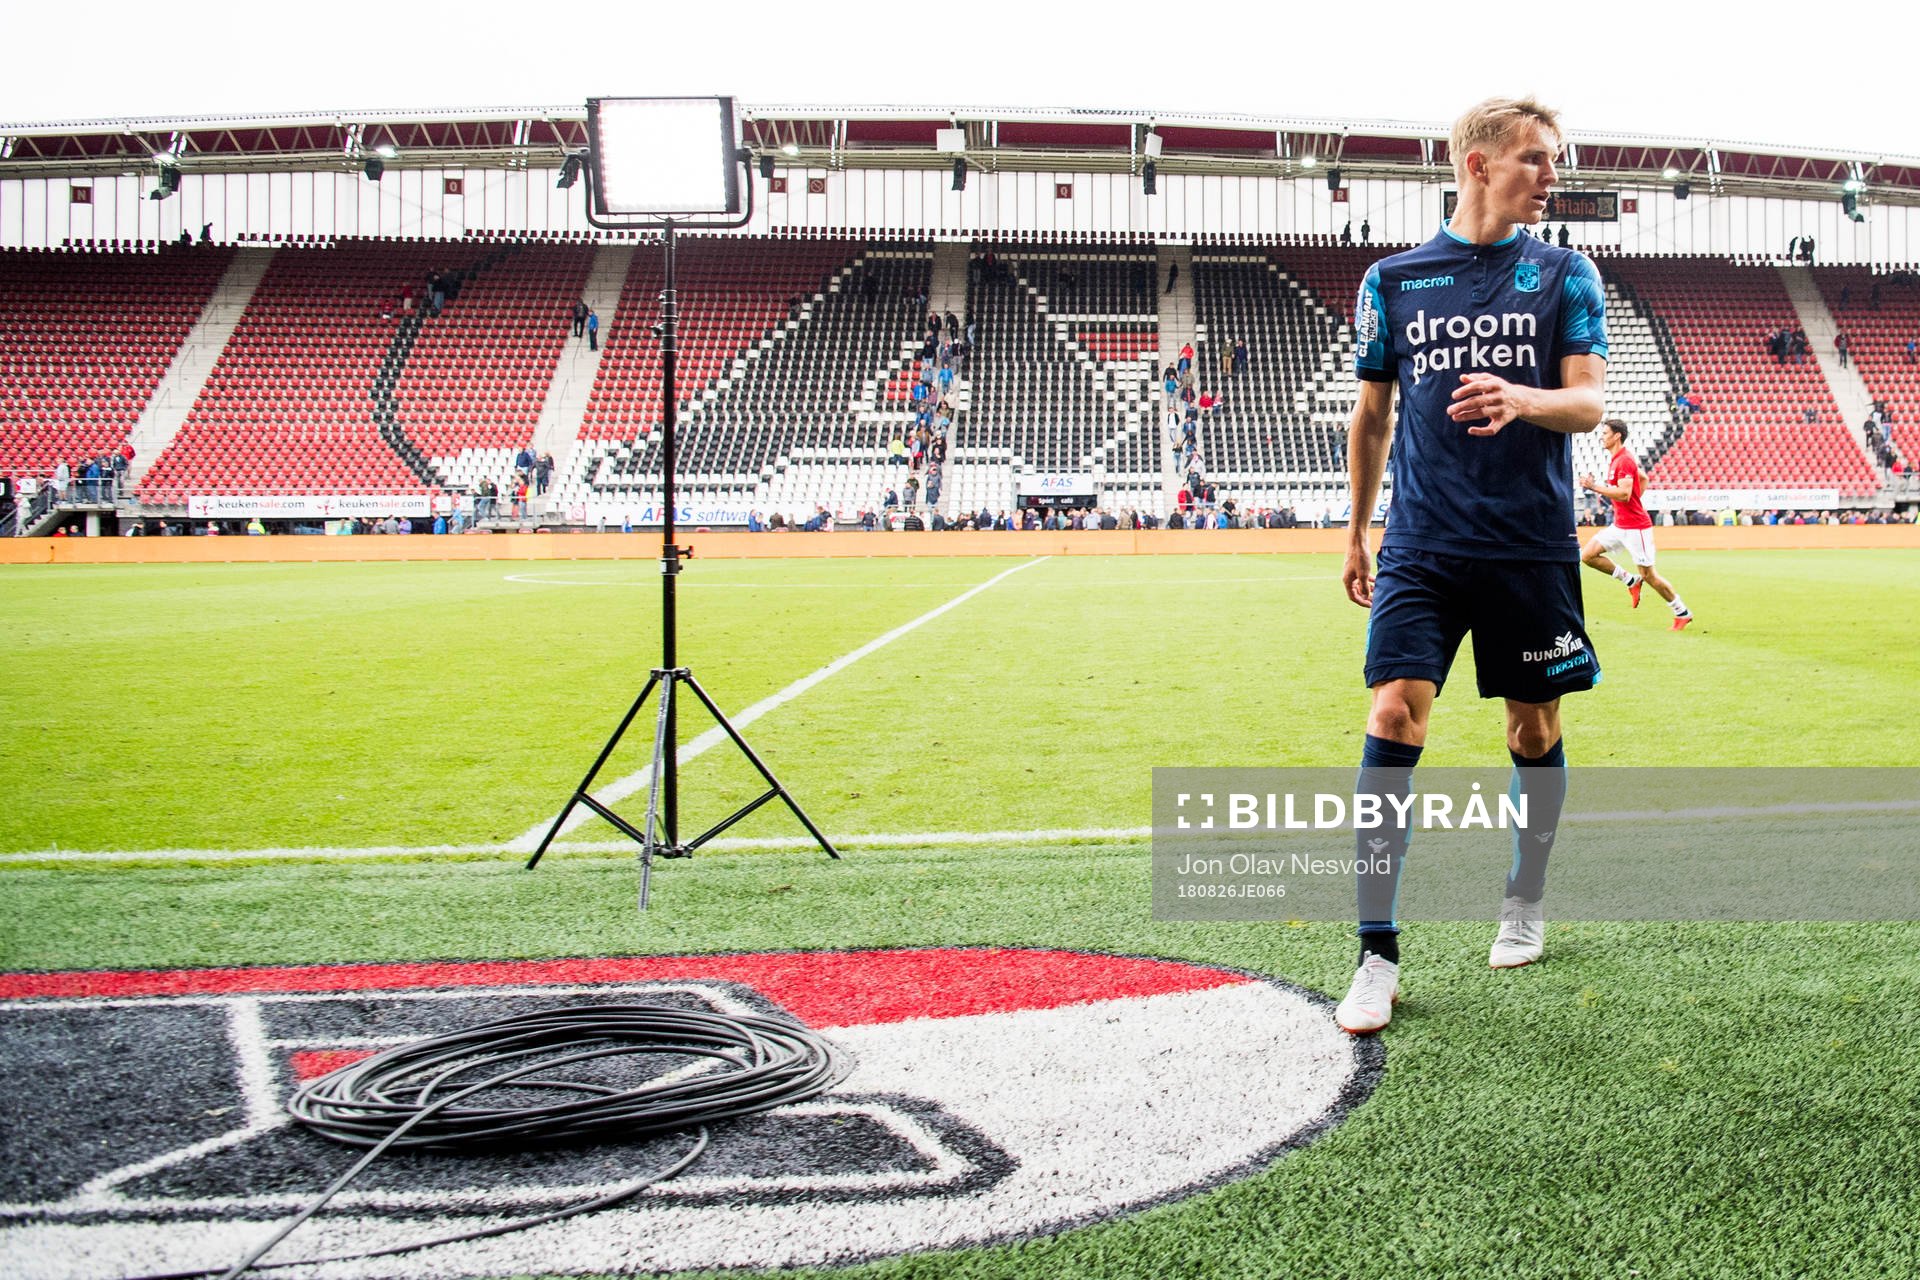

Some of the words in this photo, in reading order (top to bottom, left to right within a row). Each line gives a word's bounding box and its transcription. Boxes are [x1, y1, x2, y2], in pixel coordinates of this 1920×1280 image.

[775, 180, 782, 190] P
[77, 189, 86, 201] N
[1060, 186, 1068, 198] Q
[1337, 190, 1345, 201] R
[1401, 275, 1454, 292] macron
[1358, 289, 1373, 358] CLEANMAT
[1406, 309, 1537, 346] droom
[1412, 336, 1537, 385] parken
[1041, 477, 1073, 488] AFAS
[218, 499, 305, 509] keukensale.com
[339, 499, 424, 508] keukensale.com
[1546, 653, 1589, 677] macron
